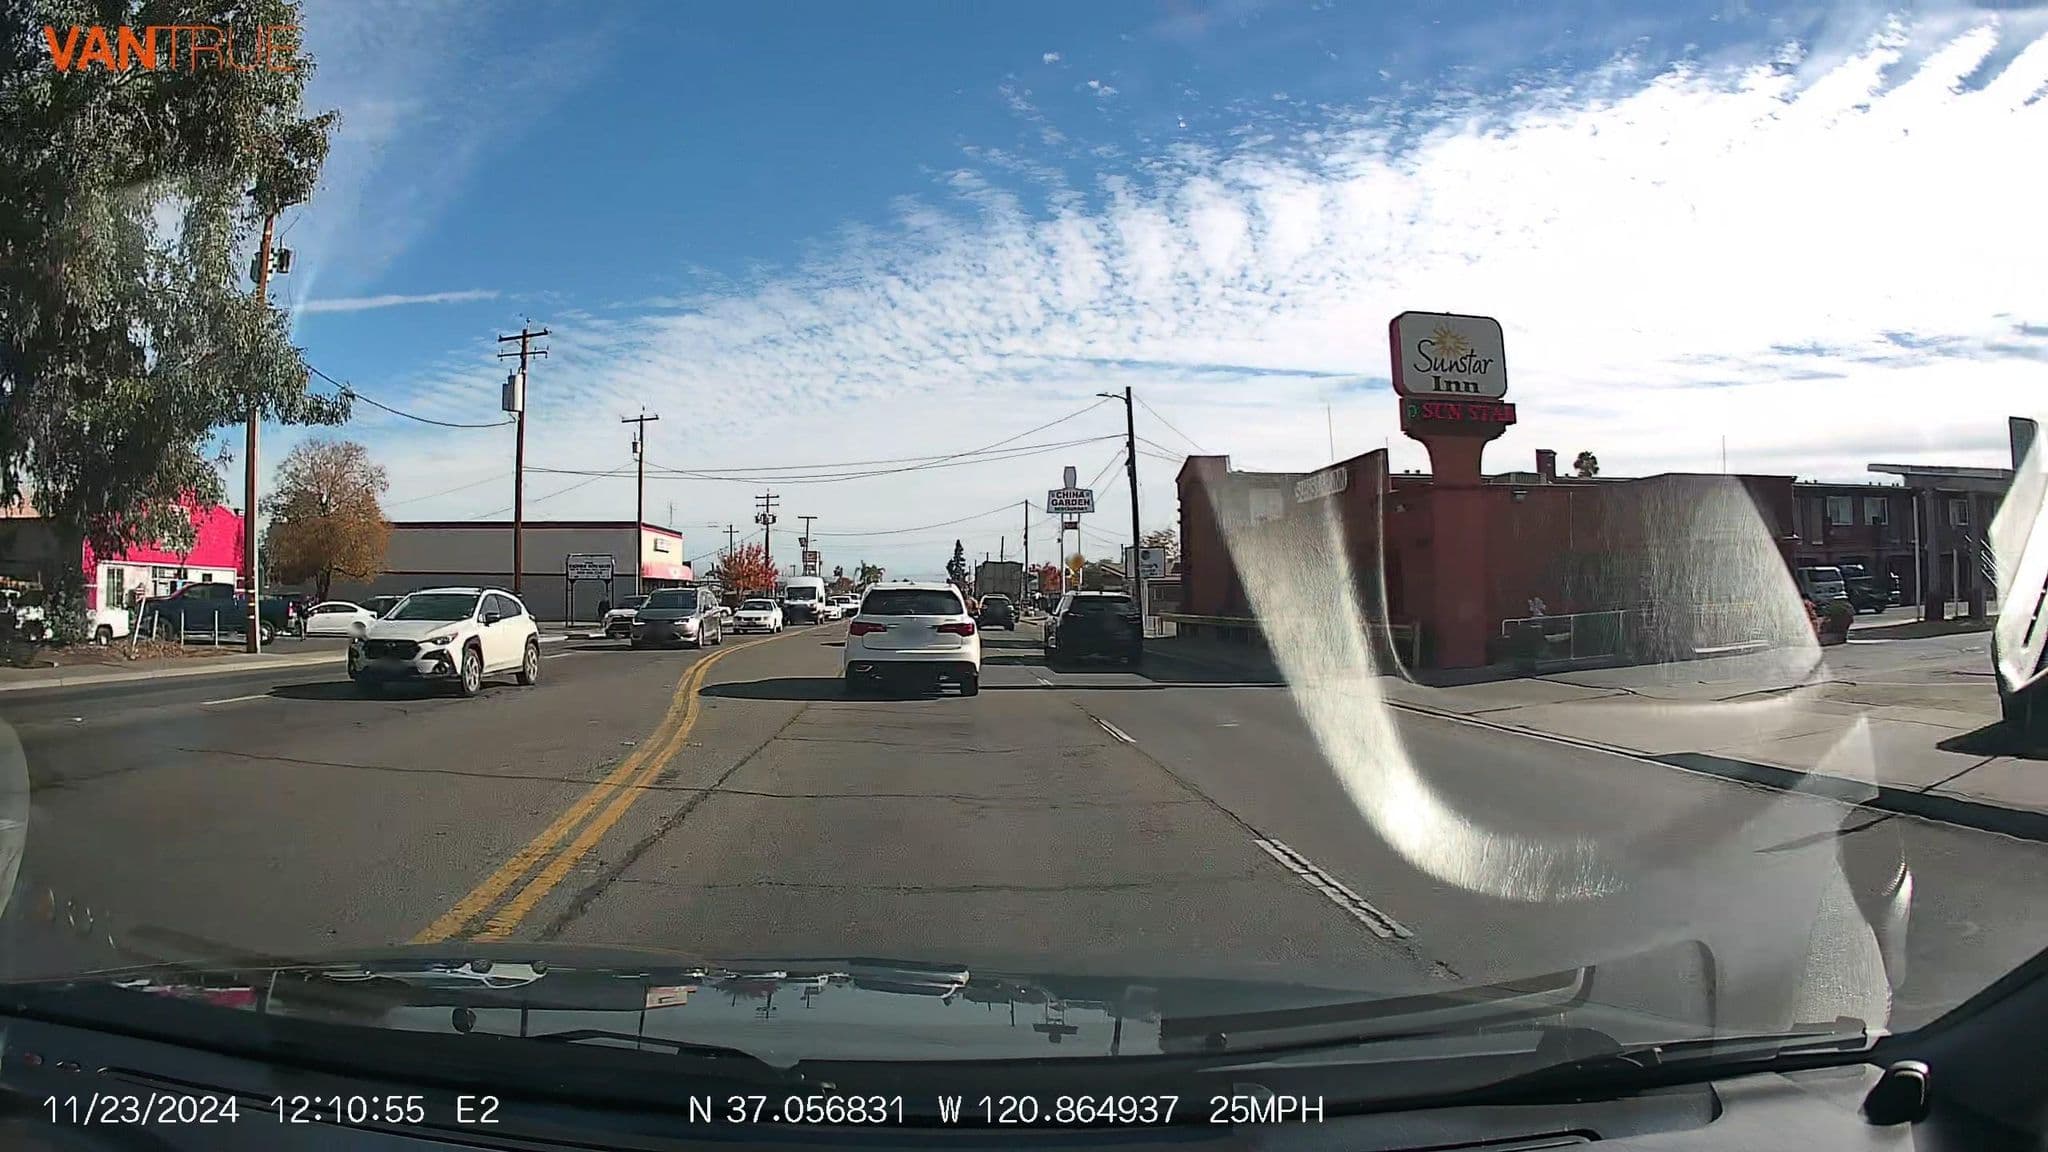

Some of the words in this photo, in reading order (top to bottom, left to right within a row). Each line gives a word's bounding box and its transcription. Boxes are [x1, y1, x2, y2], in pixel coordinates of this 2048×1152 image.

[1413, 339, 1494, 375] Sunstar
[1432, 375, 1480, 393] Inn
[1056, 491, 1085, 499] CHINA
